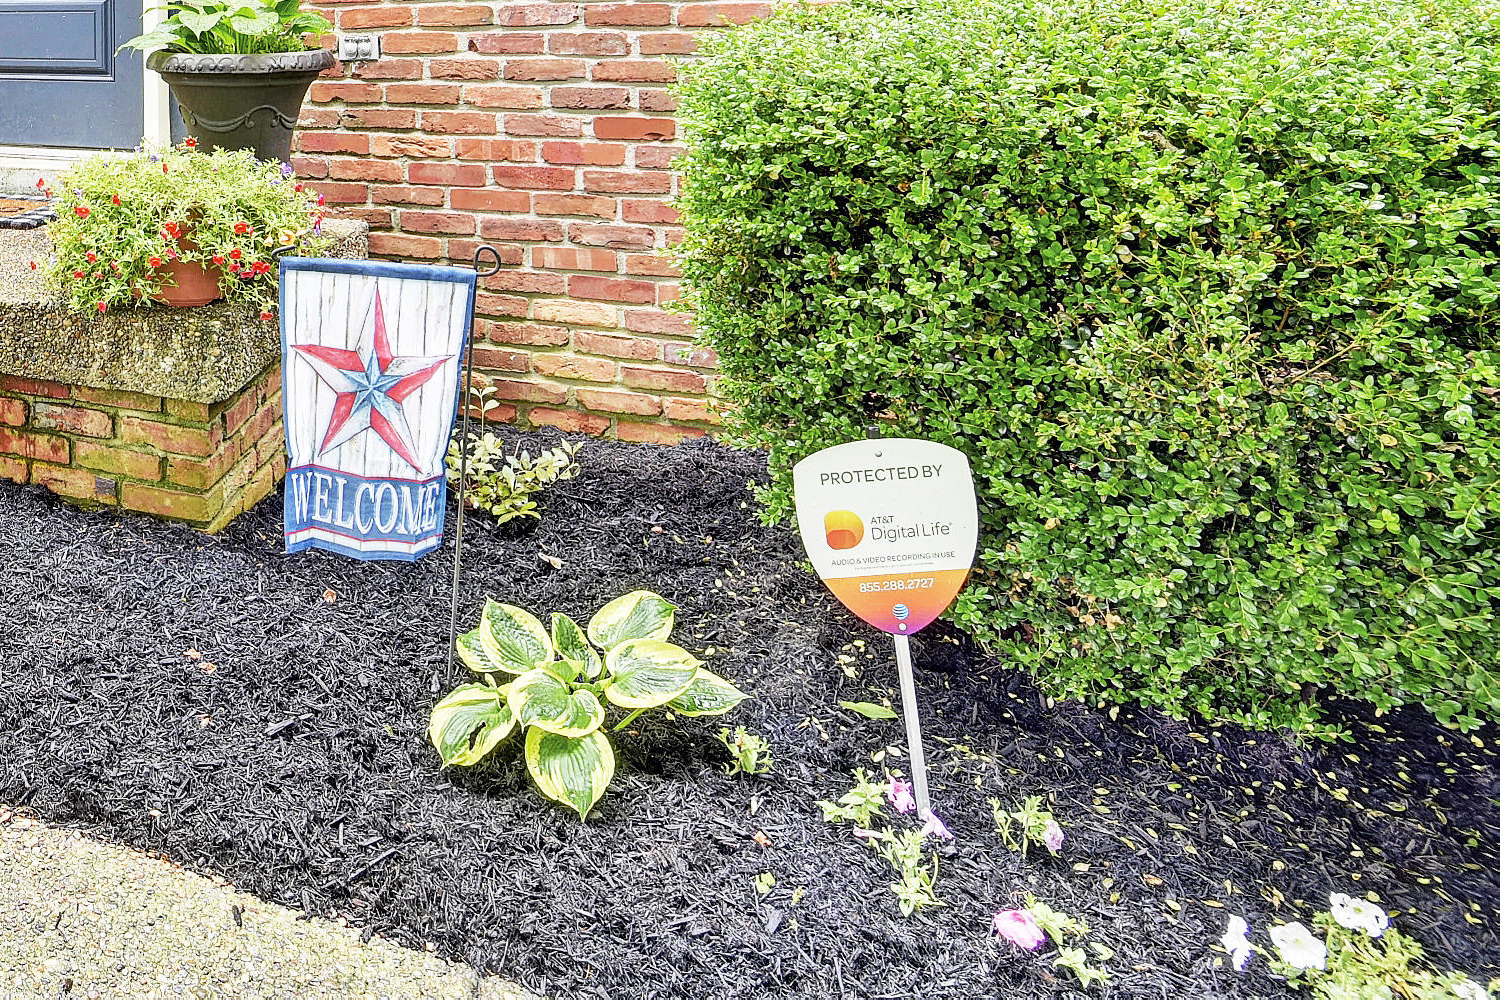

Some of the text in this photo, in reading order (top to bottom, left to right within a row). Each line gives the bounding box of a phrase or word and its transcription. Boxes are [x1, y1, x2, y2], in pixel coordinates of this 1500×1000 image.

[820, 464, 943, 486] PROTECTED BY
[291, 472, 441, 536] WELCOME
[870, 515, 895, 525] AT&T
[871, 524, 920, 543] Digital
[831, 558, 856, 566] AUDIO
[862, 556, 886, 564] VIDEO
[886, 552, 932, 562] RECORDING
[859, 577, 935, 593] 855.288.2727
